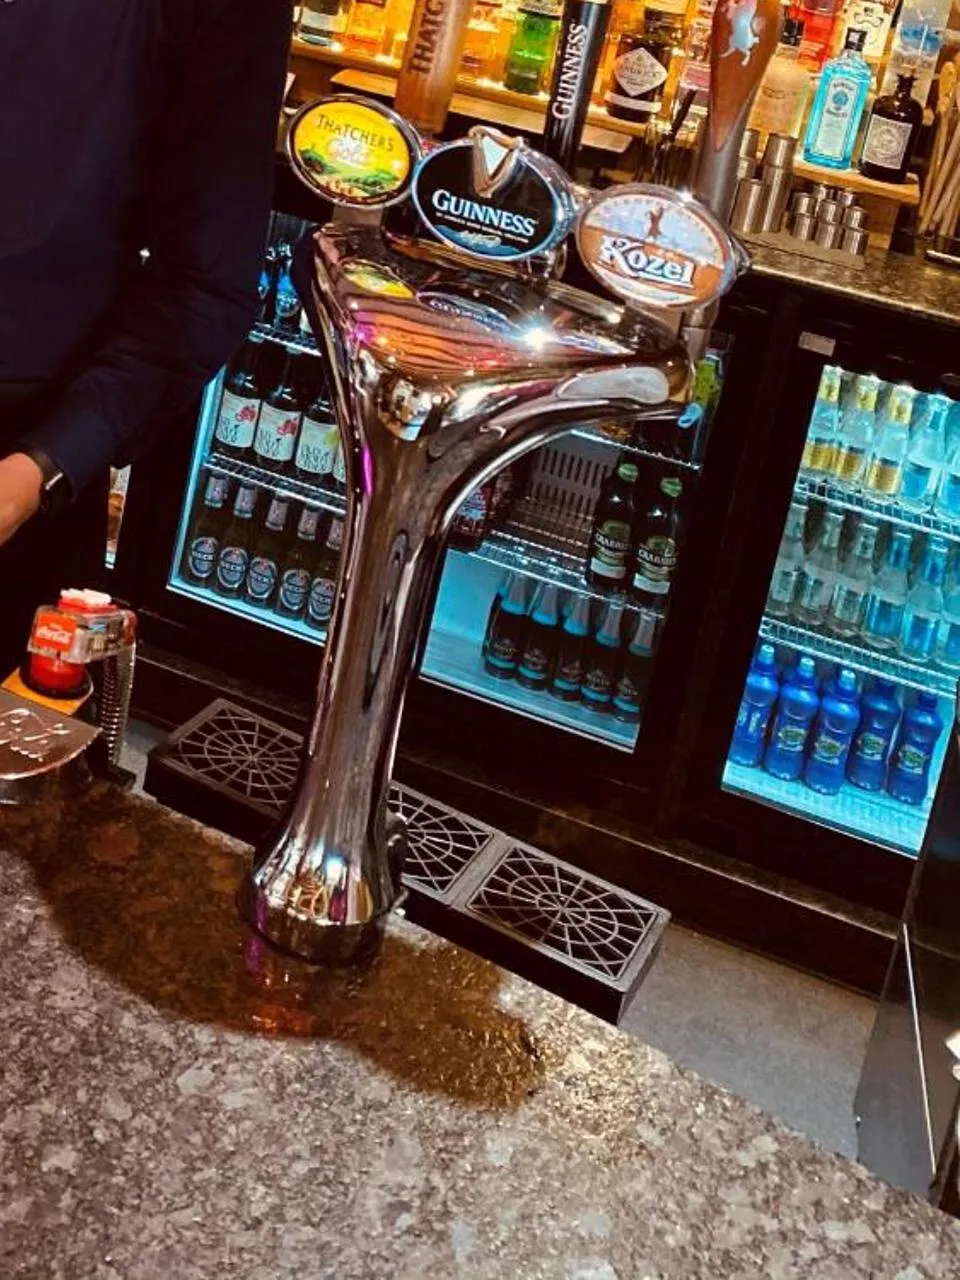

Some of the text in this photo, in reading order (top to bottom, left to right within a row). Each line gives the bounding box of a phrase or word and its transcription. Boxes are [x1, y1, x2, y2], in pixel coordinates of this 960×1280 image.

[551, 22, 588, 120] GUINNESS
[316, 114, 395, 153] THATCHERS
[431, 188, 536, 237] GUINNESS
[599, 234, 695, 286] Kozel
